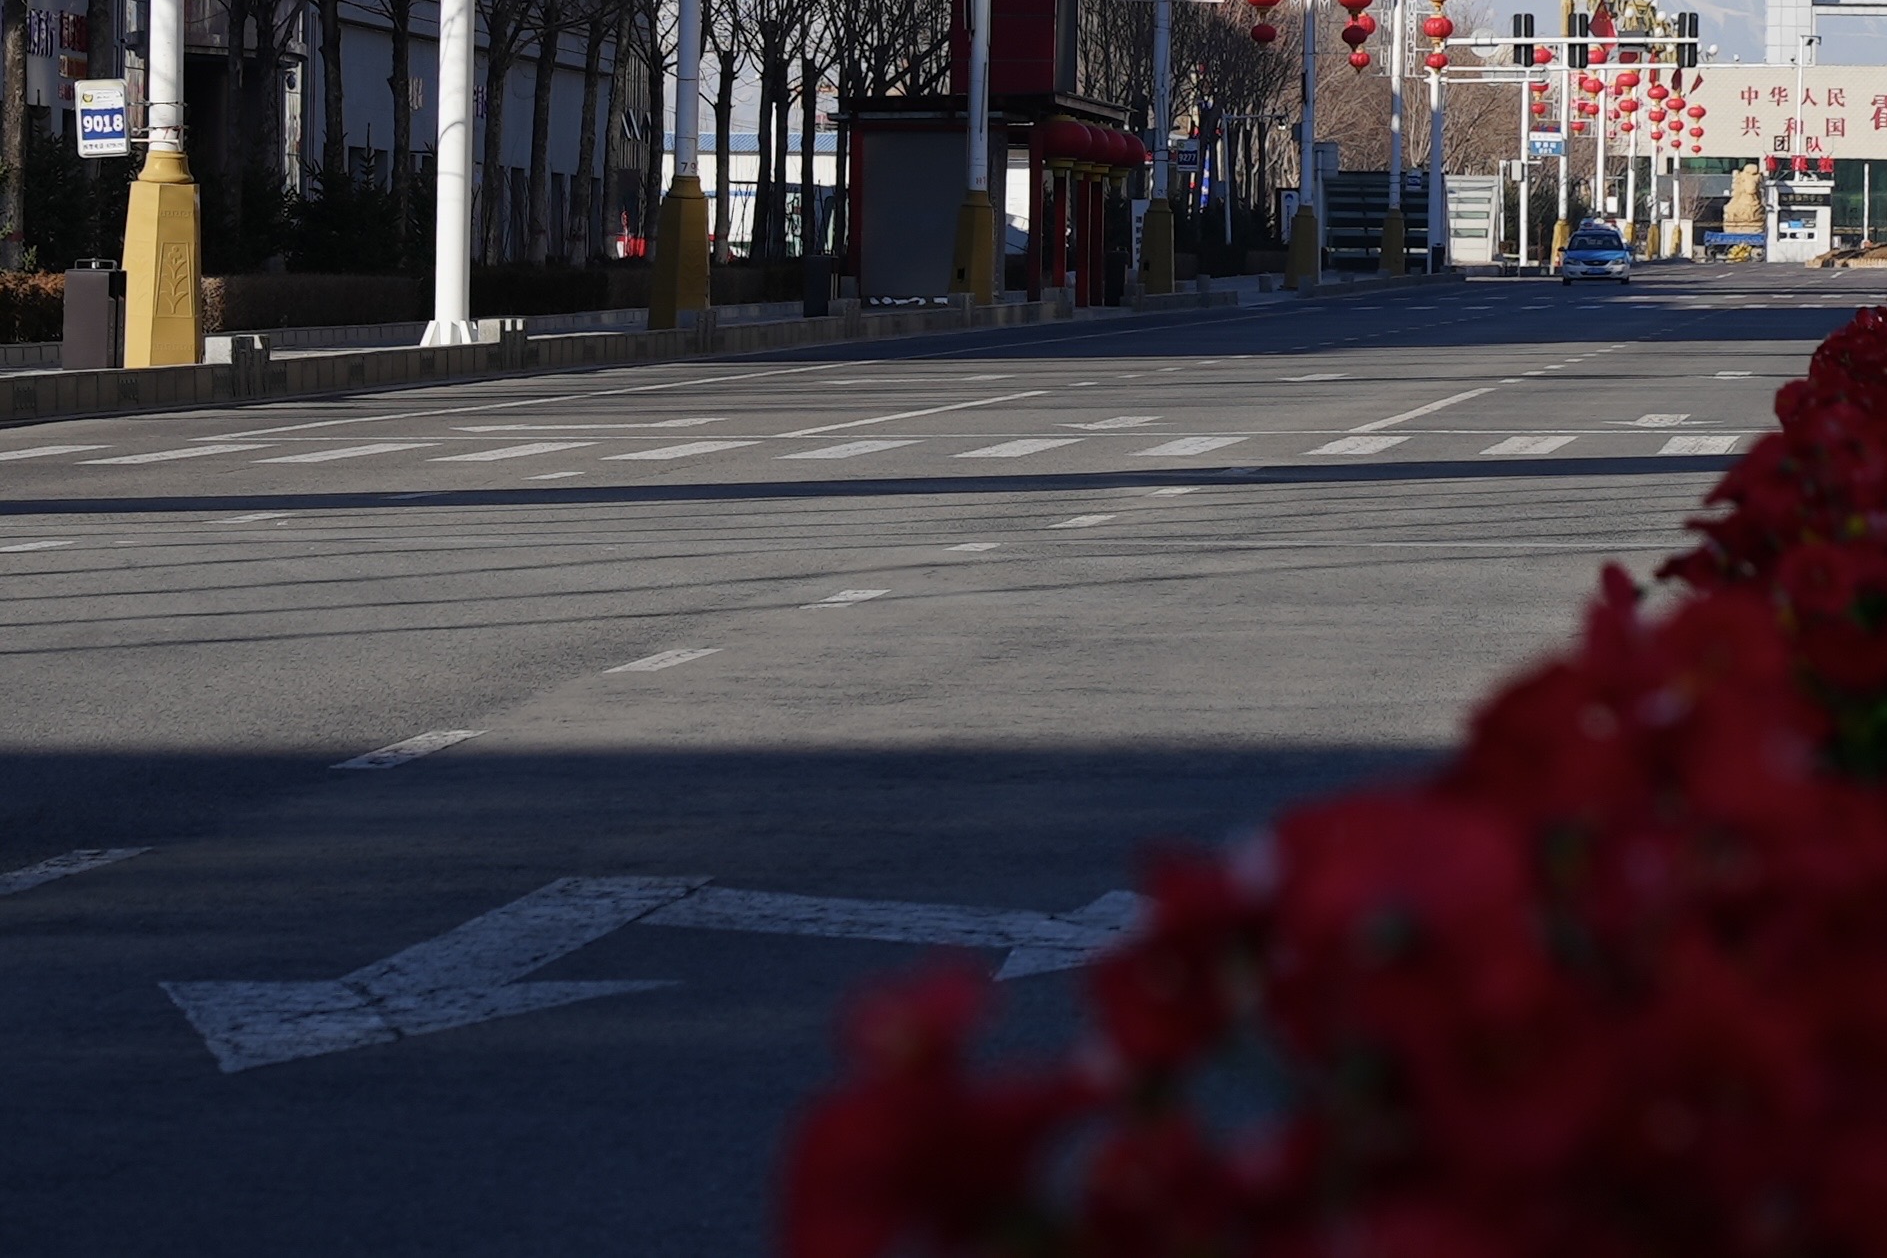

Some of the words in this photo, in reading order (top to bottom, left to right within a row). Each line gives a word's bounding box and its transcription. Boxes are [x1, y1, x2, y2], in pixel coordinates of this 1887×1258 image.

[1740, 86, 1846, 108] 中华人民
[82, 113, 124, 133] 9018
[1740, 116, 1846, 137] 共和国
[1774, 135, 1823, 153] 团队
